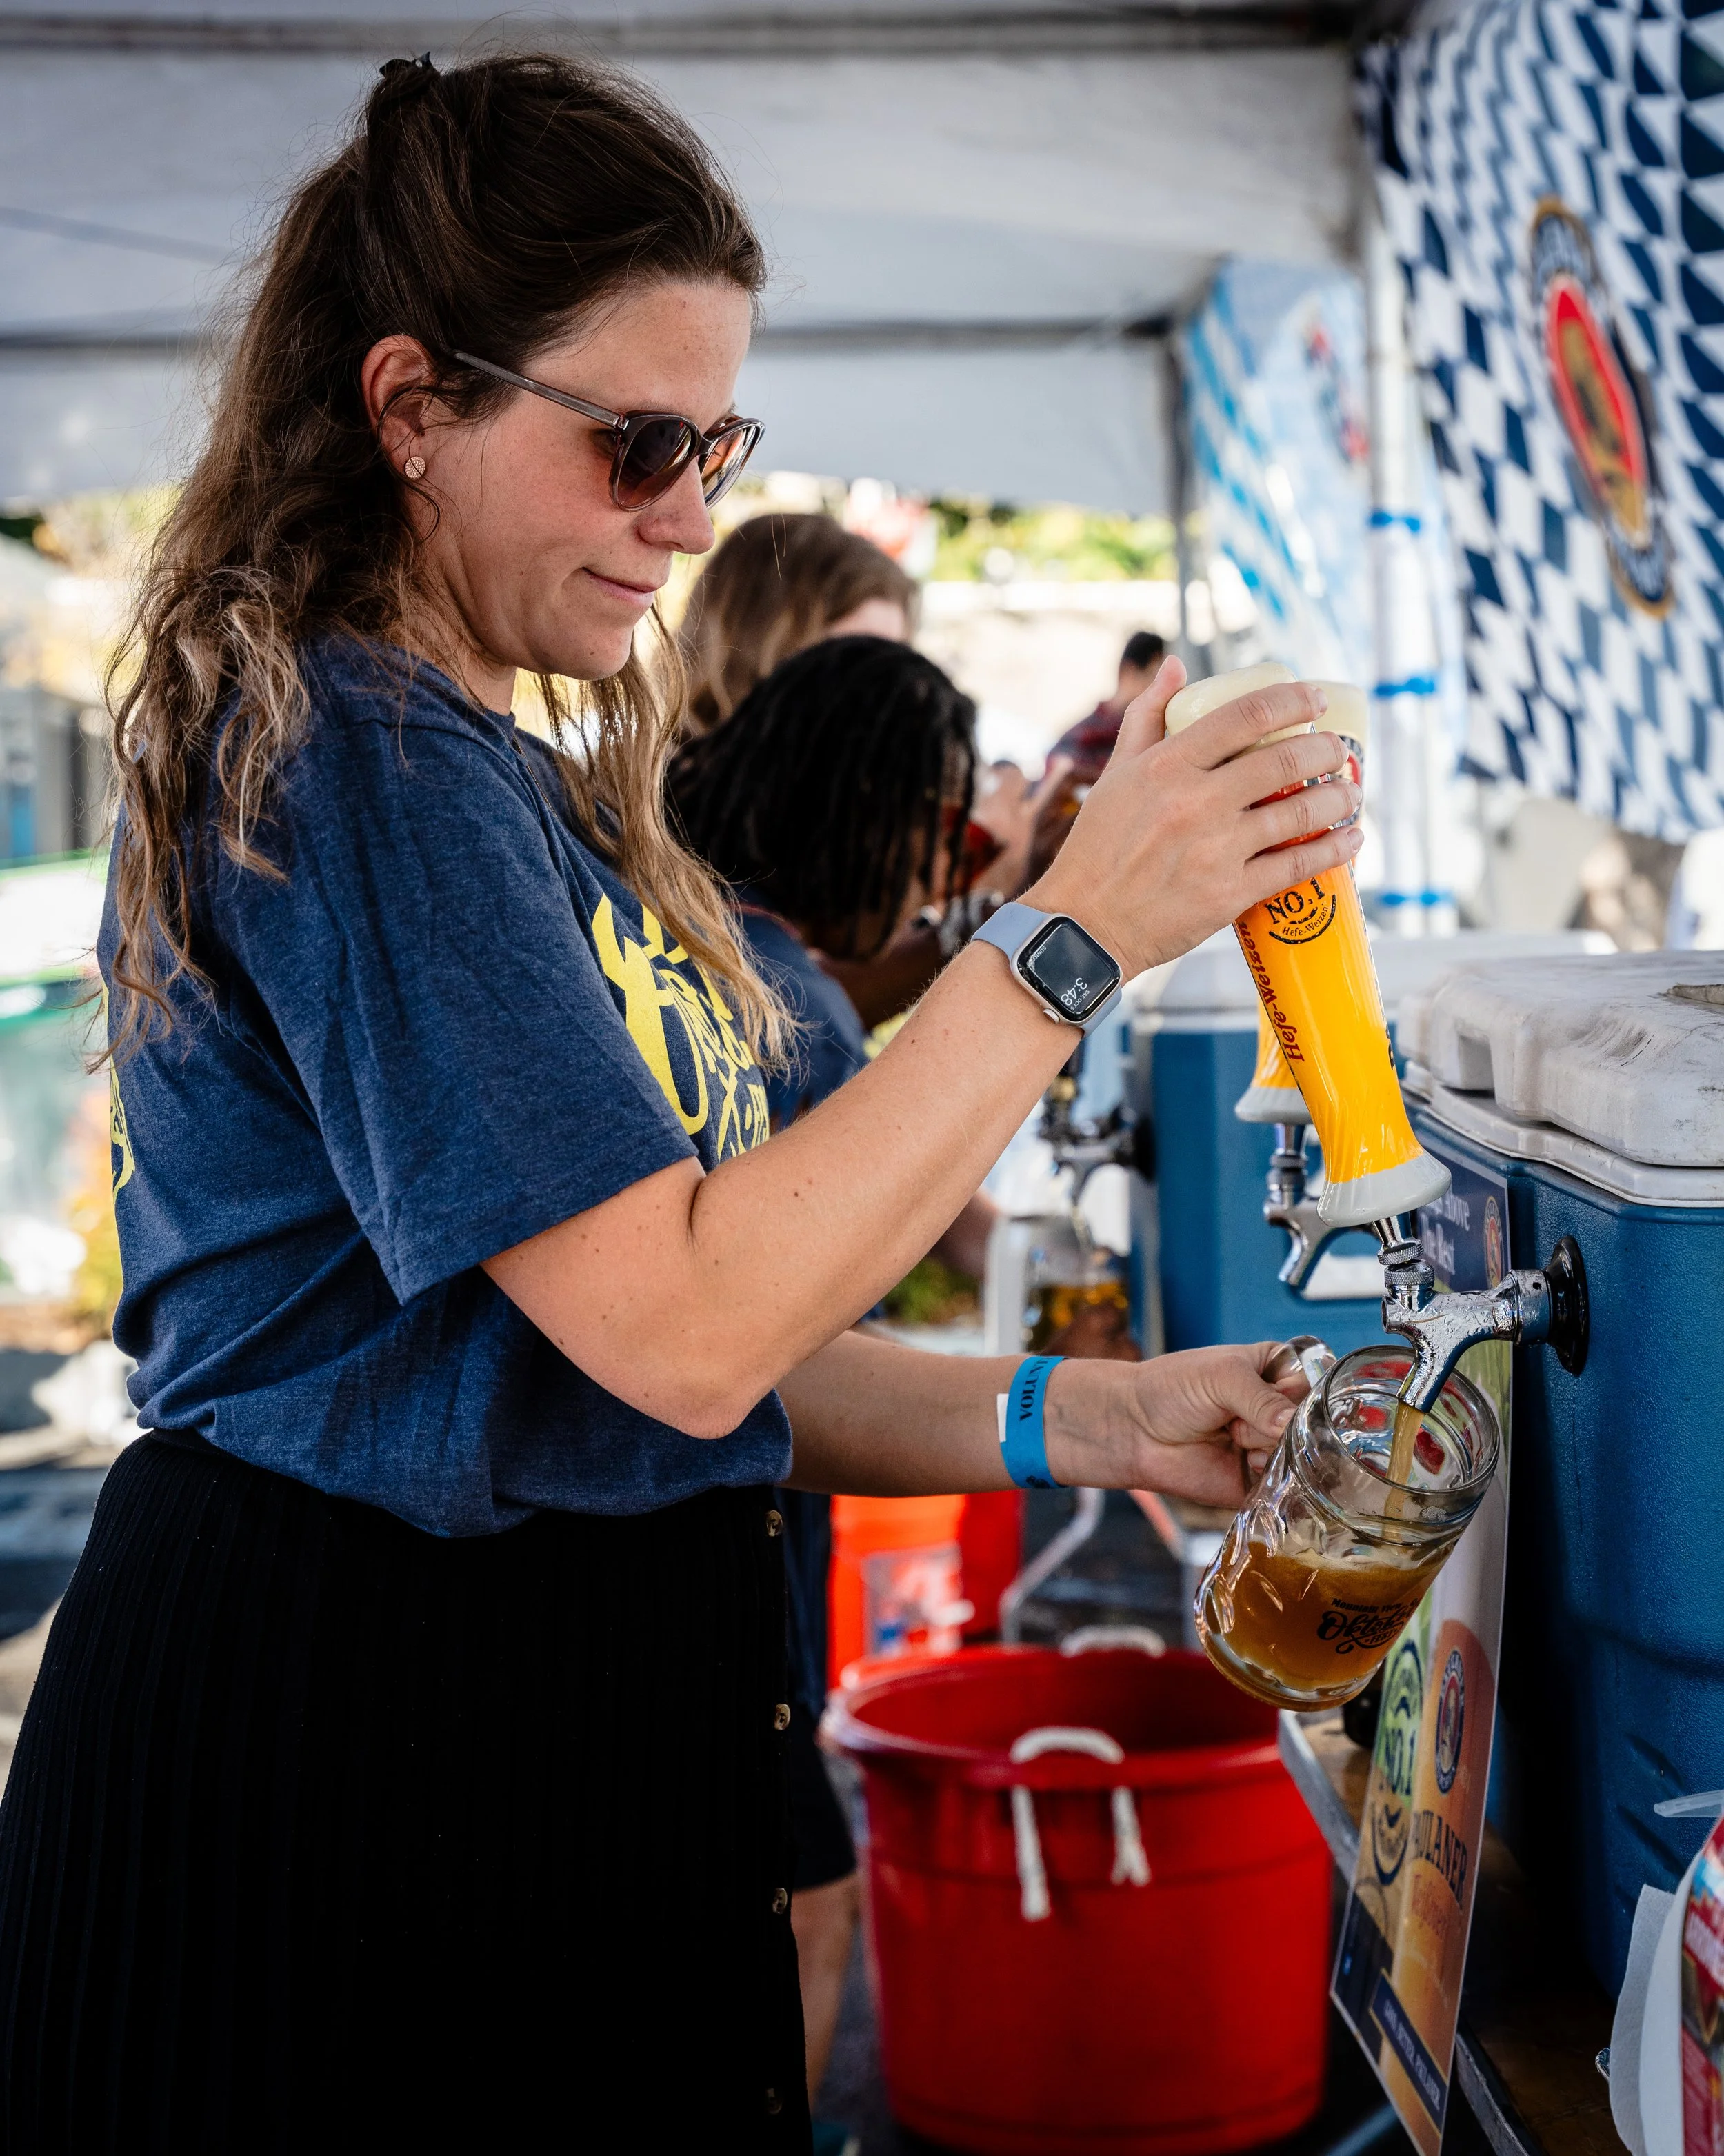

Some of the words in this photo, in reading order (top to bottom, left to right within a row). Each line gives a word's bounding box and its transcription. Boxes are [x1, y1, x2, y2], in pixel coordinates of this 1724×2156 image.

[1265, 877, 1325, 924] NO.1
[1282, 906, 1328, 937] Hefe-Weizen
[1061, 977, 1087, 1006] 3:48
[1074, 997, 1083, 1008] OCT
[1238, 921, 1305, 1062] Hefe-Weizen
[1331, 1597, 1379, 1613] Mountain
